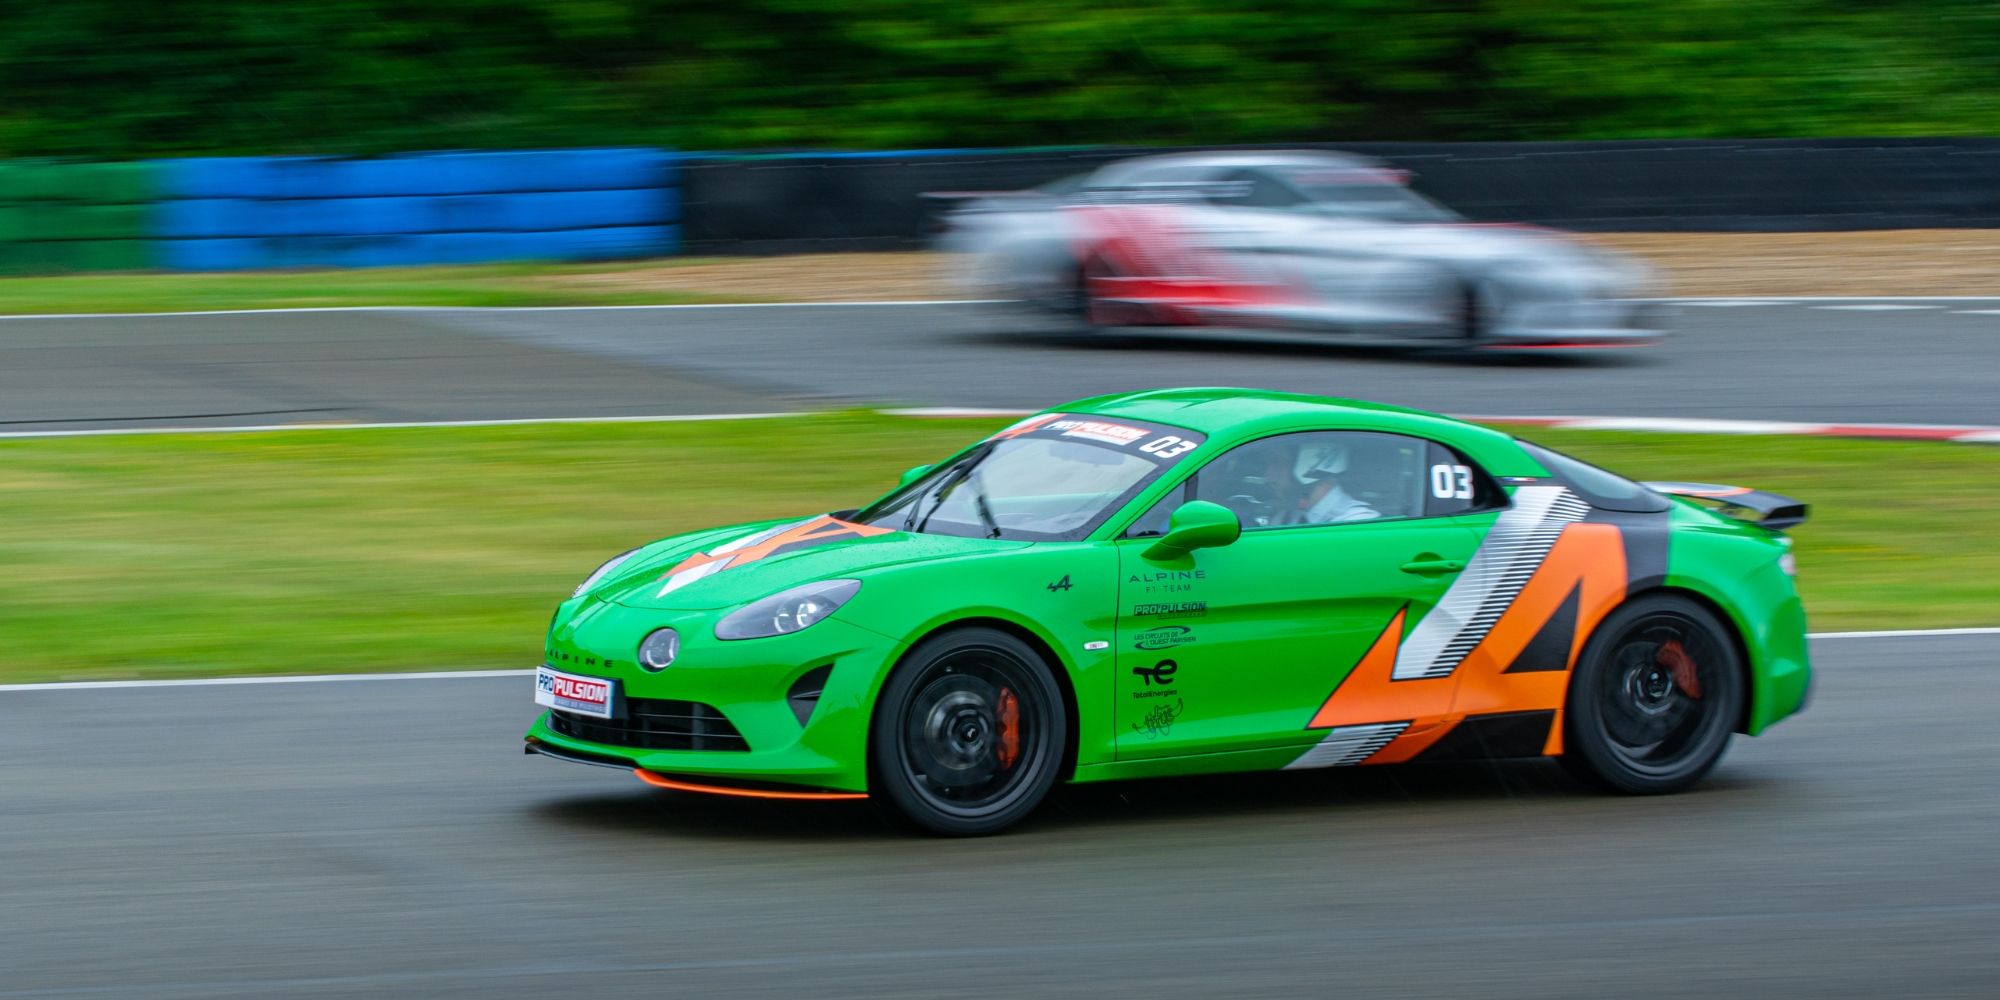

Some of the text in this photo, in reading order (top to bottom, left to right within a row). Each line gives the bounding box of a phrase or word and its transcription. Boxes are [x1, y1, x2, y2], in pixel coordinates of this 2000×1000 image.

[1139, 435, 1198, 459] 03
[1431, 464, 1474, 499] 03
[1129, 569, 1206, 583] ALPINE
[1145, 583, 1192, 593] F1 TEAM
[1134, 633, 1144, 641] LES
[1145, 631, 1170, 640] CIRCUITS
[1132, 688, 1178, 699] TotalEnergies
